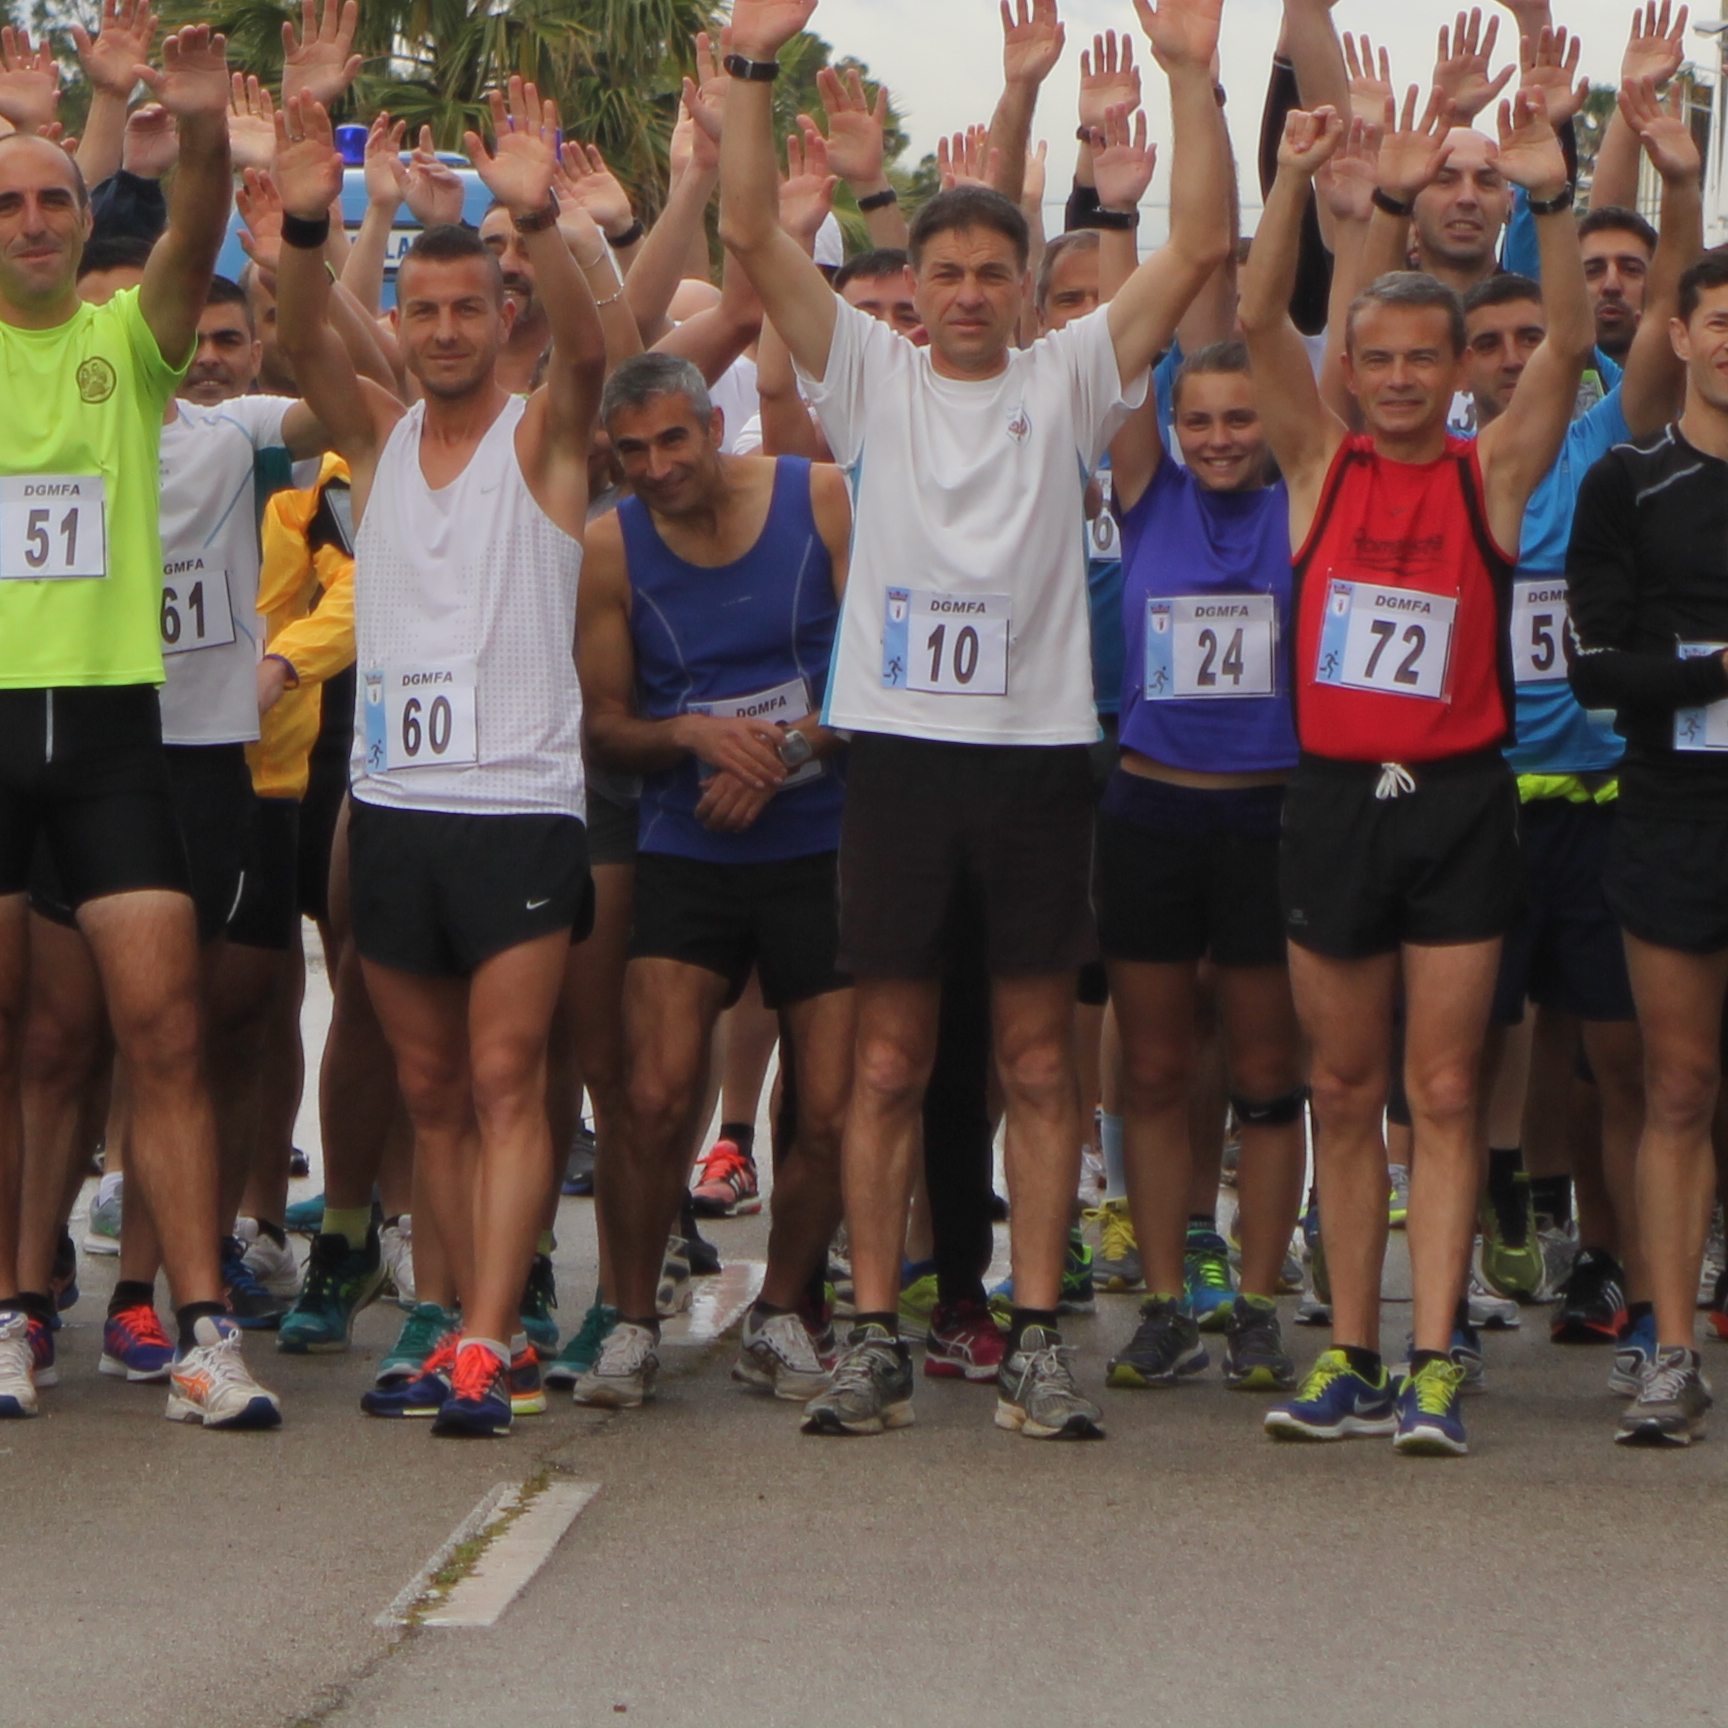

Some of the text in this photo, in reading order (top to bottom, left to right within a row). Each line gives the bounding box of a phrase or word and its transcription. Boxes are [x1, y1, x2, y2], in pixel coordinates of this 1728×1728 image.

[24, 484, 80, 497] DGMFA
[24, 507, 79, 568] 51
[164, 558, 205, 575] GMFA
[1375, 595, 1432, 614] DGMFA
[1528, 589, 1569, 603] DGM
[161, 581, 205, 644] 61
[930, 599, 986, 615] DGMFA
[1194, 605, 1249, 618] DGMFA
[927, 624, 979, 685] 10
[1197, 627, 1244, 687] 24
[1364, 619, 1426, 686] 72
[402, 671, 453, 687] DGMFA
[736, 694, 787, 718] DGMFA
[402, 695, 452, 757] 60
